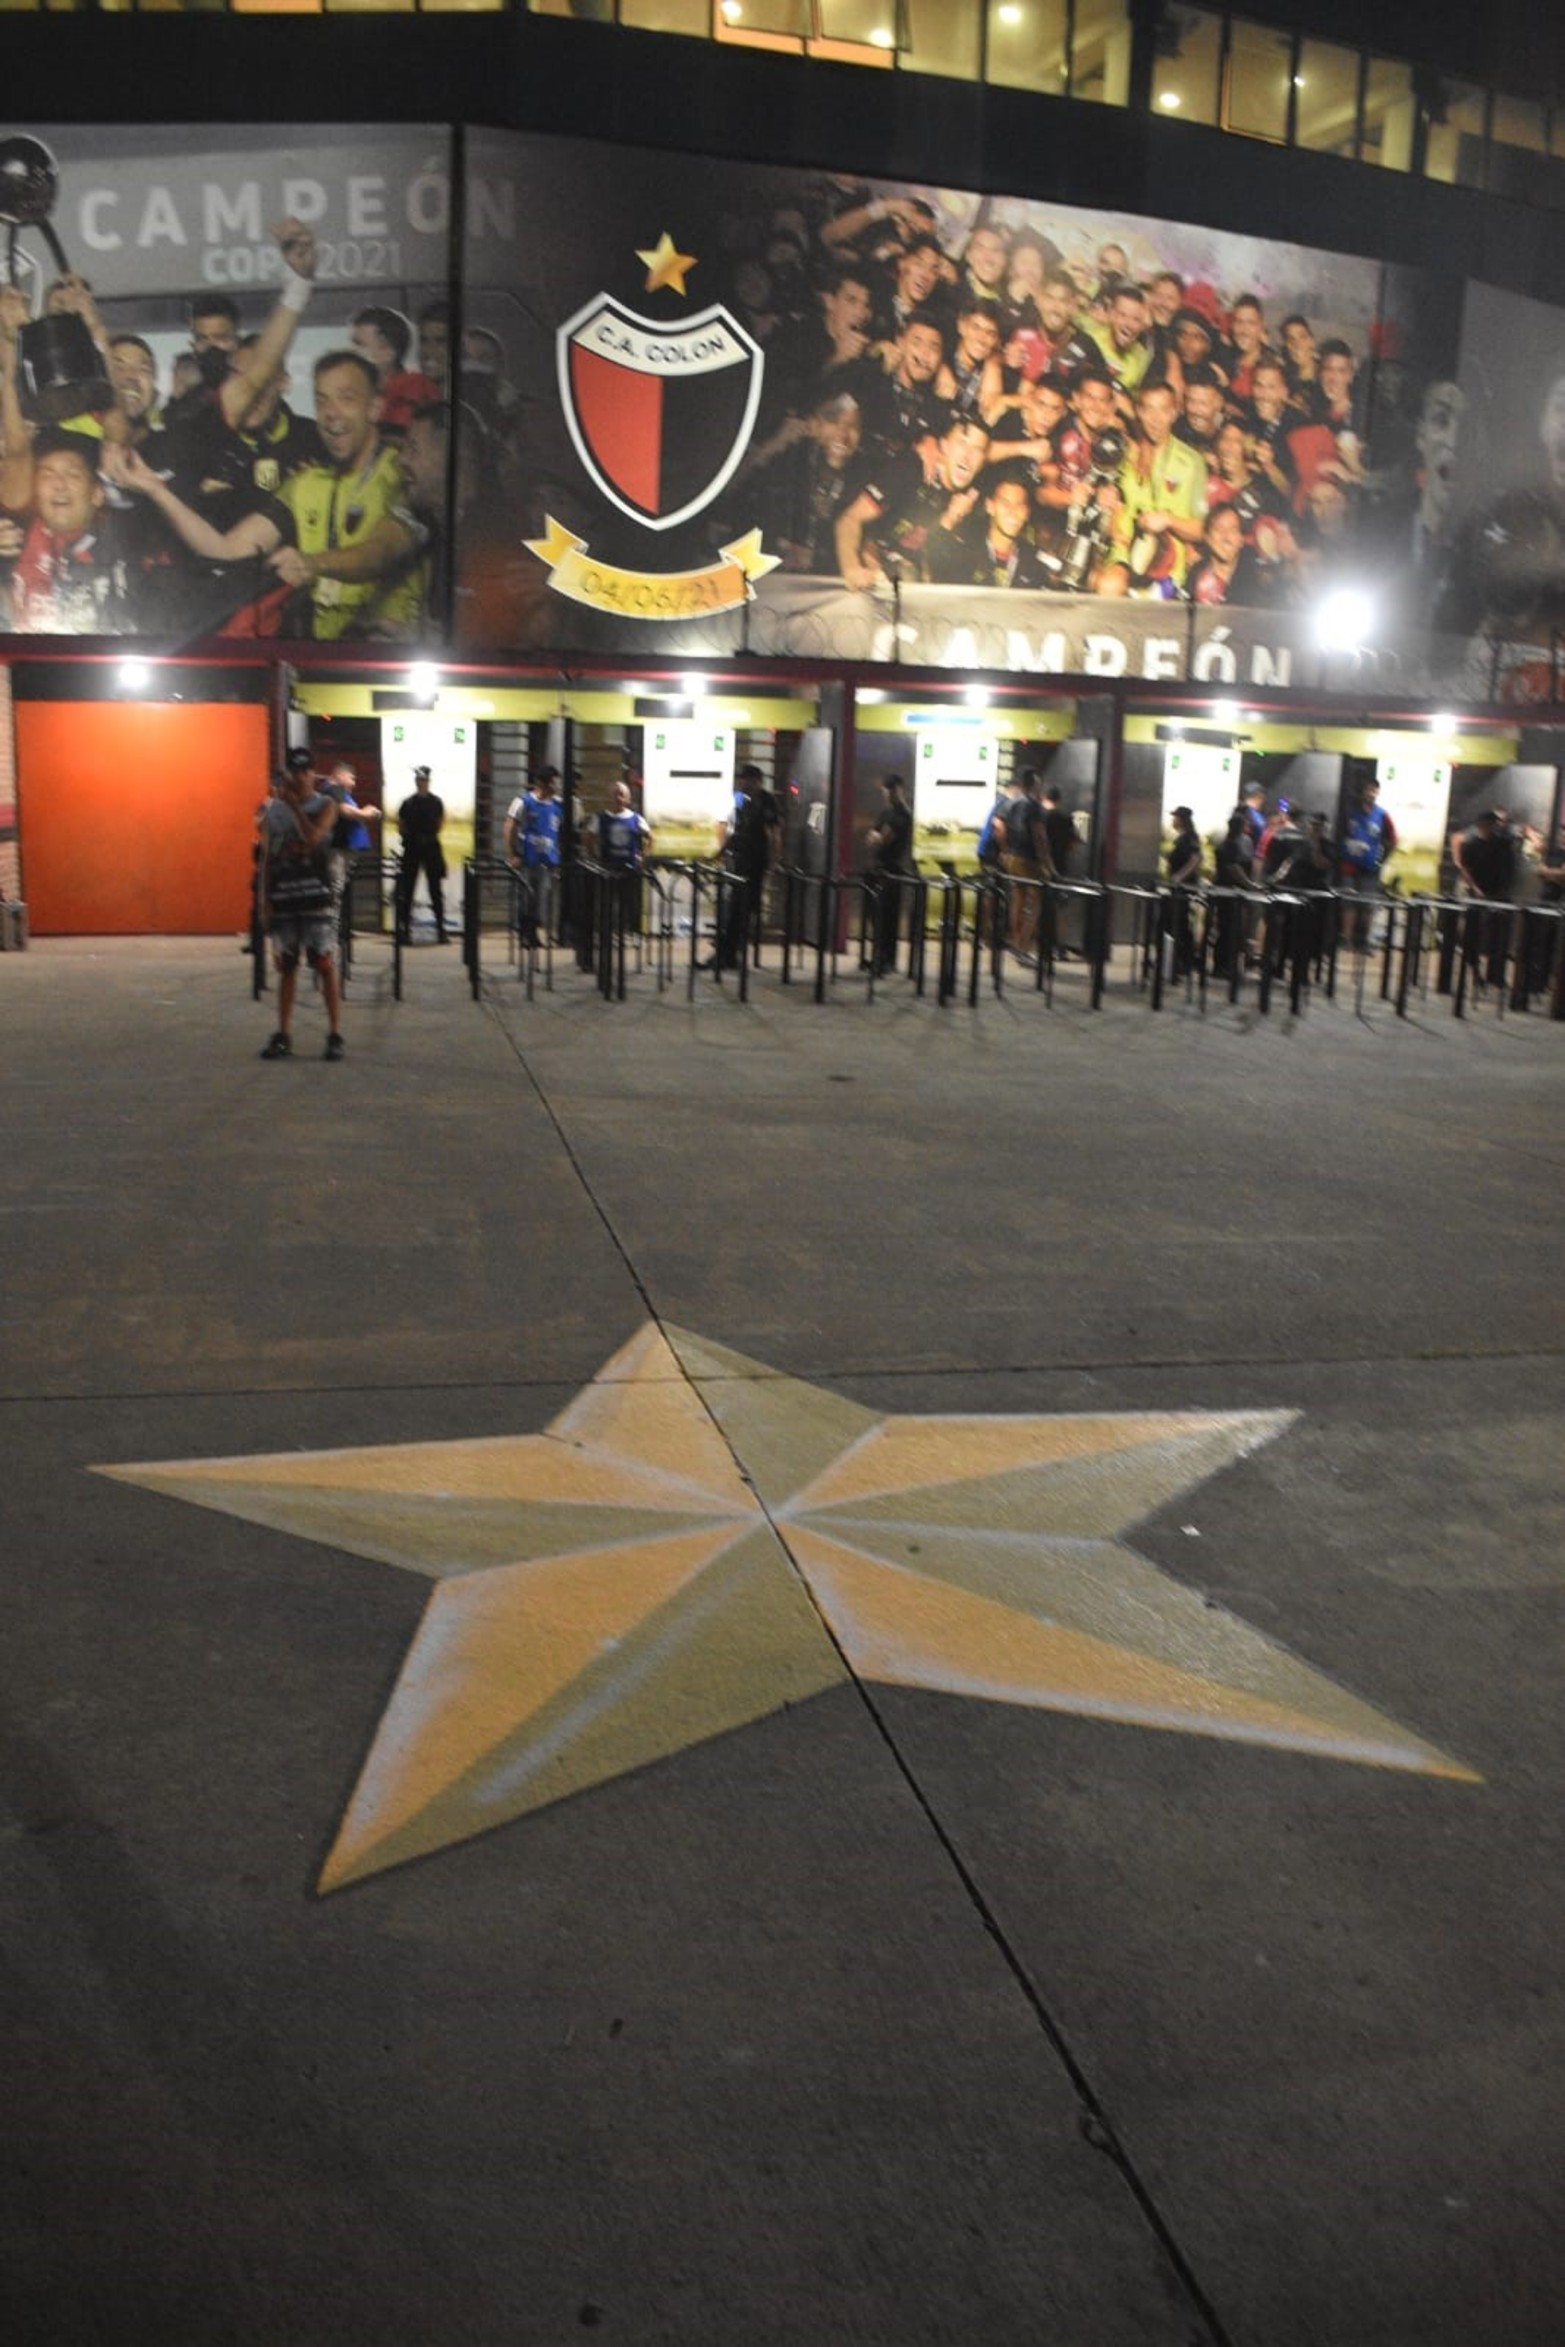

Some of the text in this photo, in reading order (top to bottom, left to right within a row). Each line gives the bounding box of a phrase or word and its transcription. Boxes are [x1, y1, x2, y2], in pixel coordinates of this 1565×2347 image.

[80, 161, 516, 249] CAMPEÓN
[202, 241, 400, 284] COP 2021
[598, 327, 723, 362] C.A. COLON
